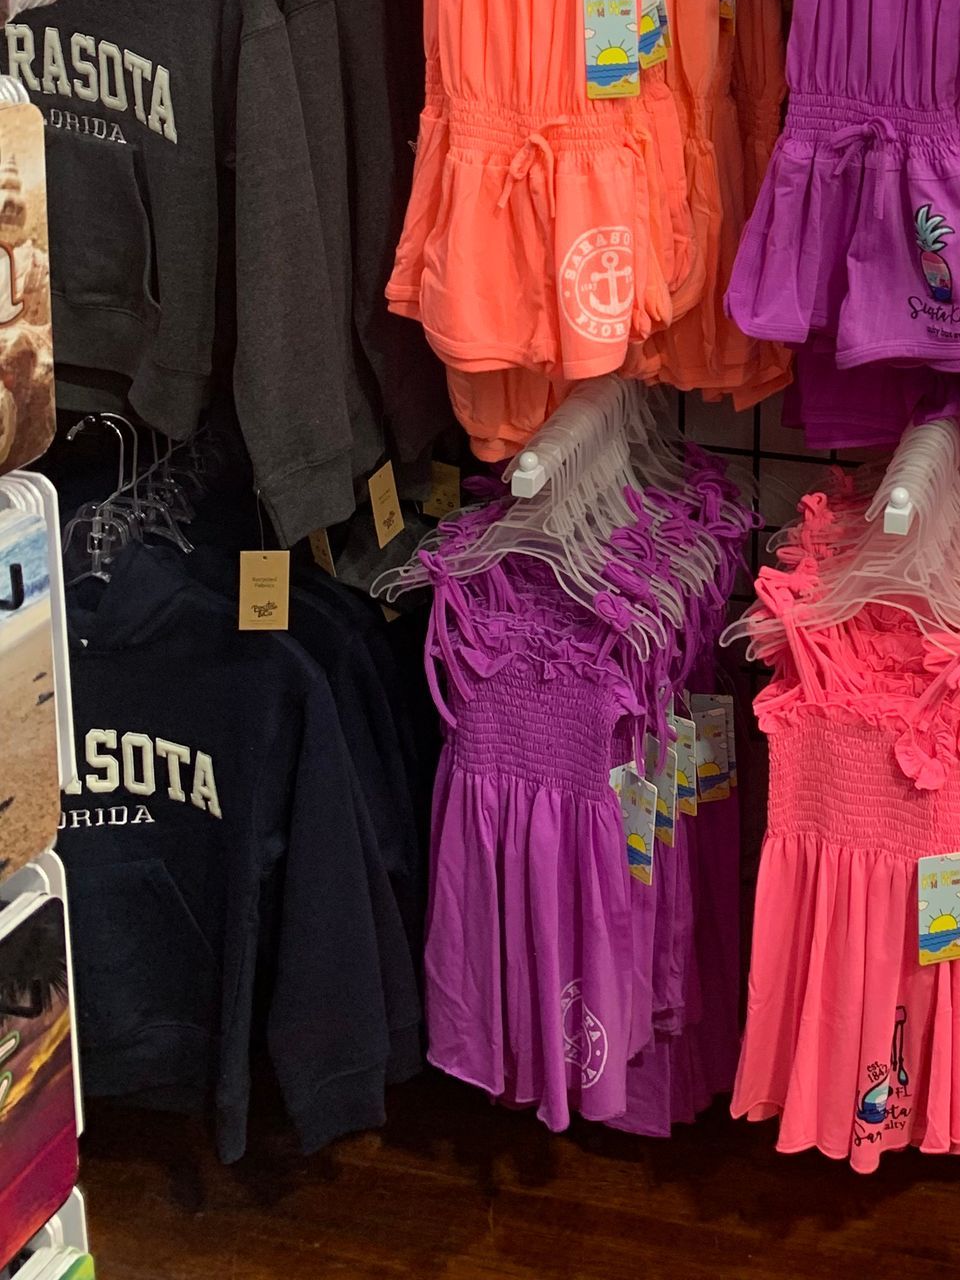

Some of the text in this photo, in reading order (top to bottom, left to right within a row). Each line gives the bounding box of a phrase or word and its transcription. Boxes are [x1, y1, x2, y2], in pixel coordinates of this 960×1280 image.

[5, 23, 178, 145] RASOTA
[64, 728, 223, 819] SOTA
[895, 1085, 912, 1099] FL
